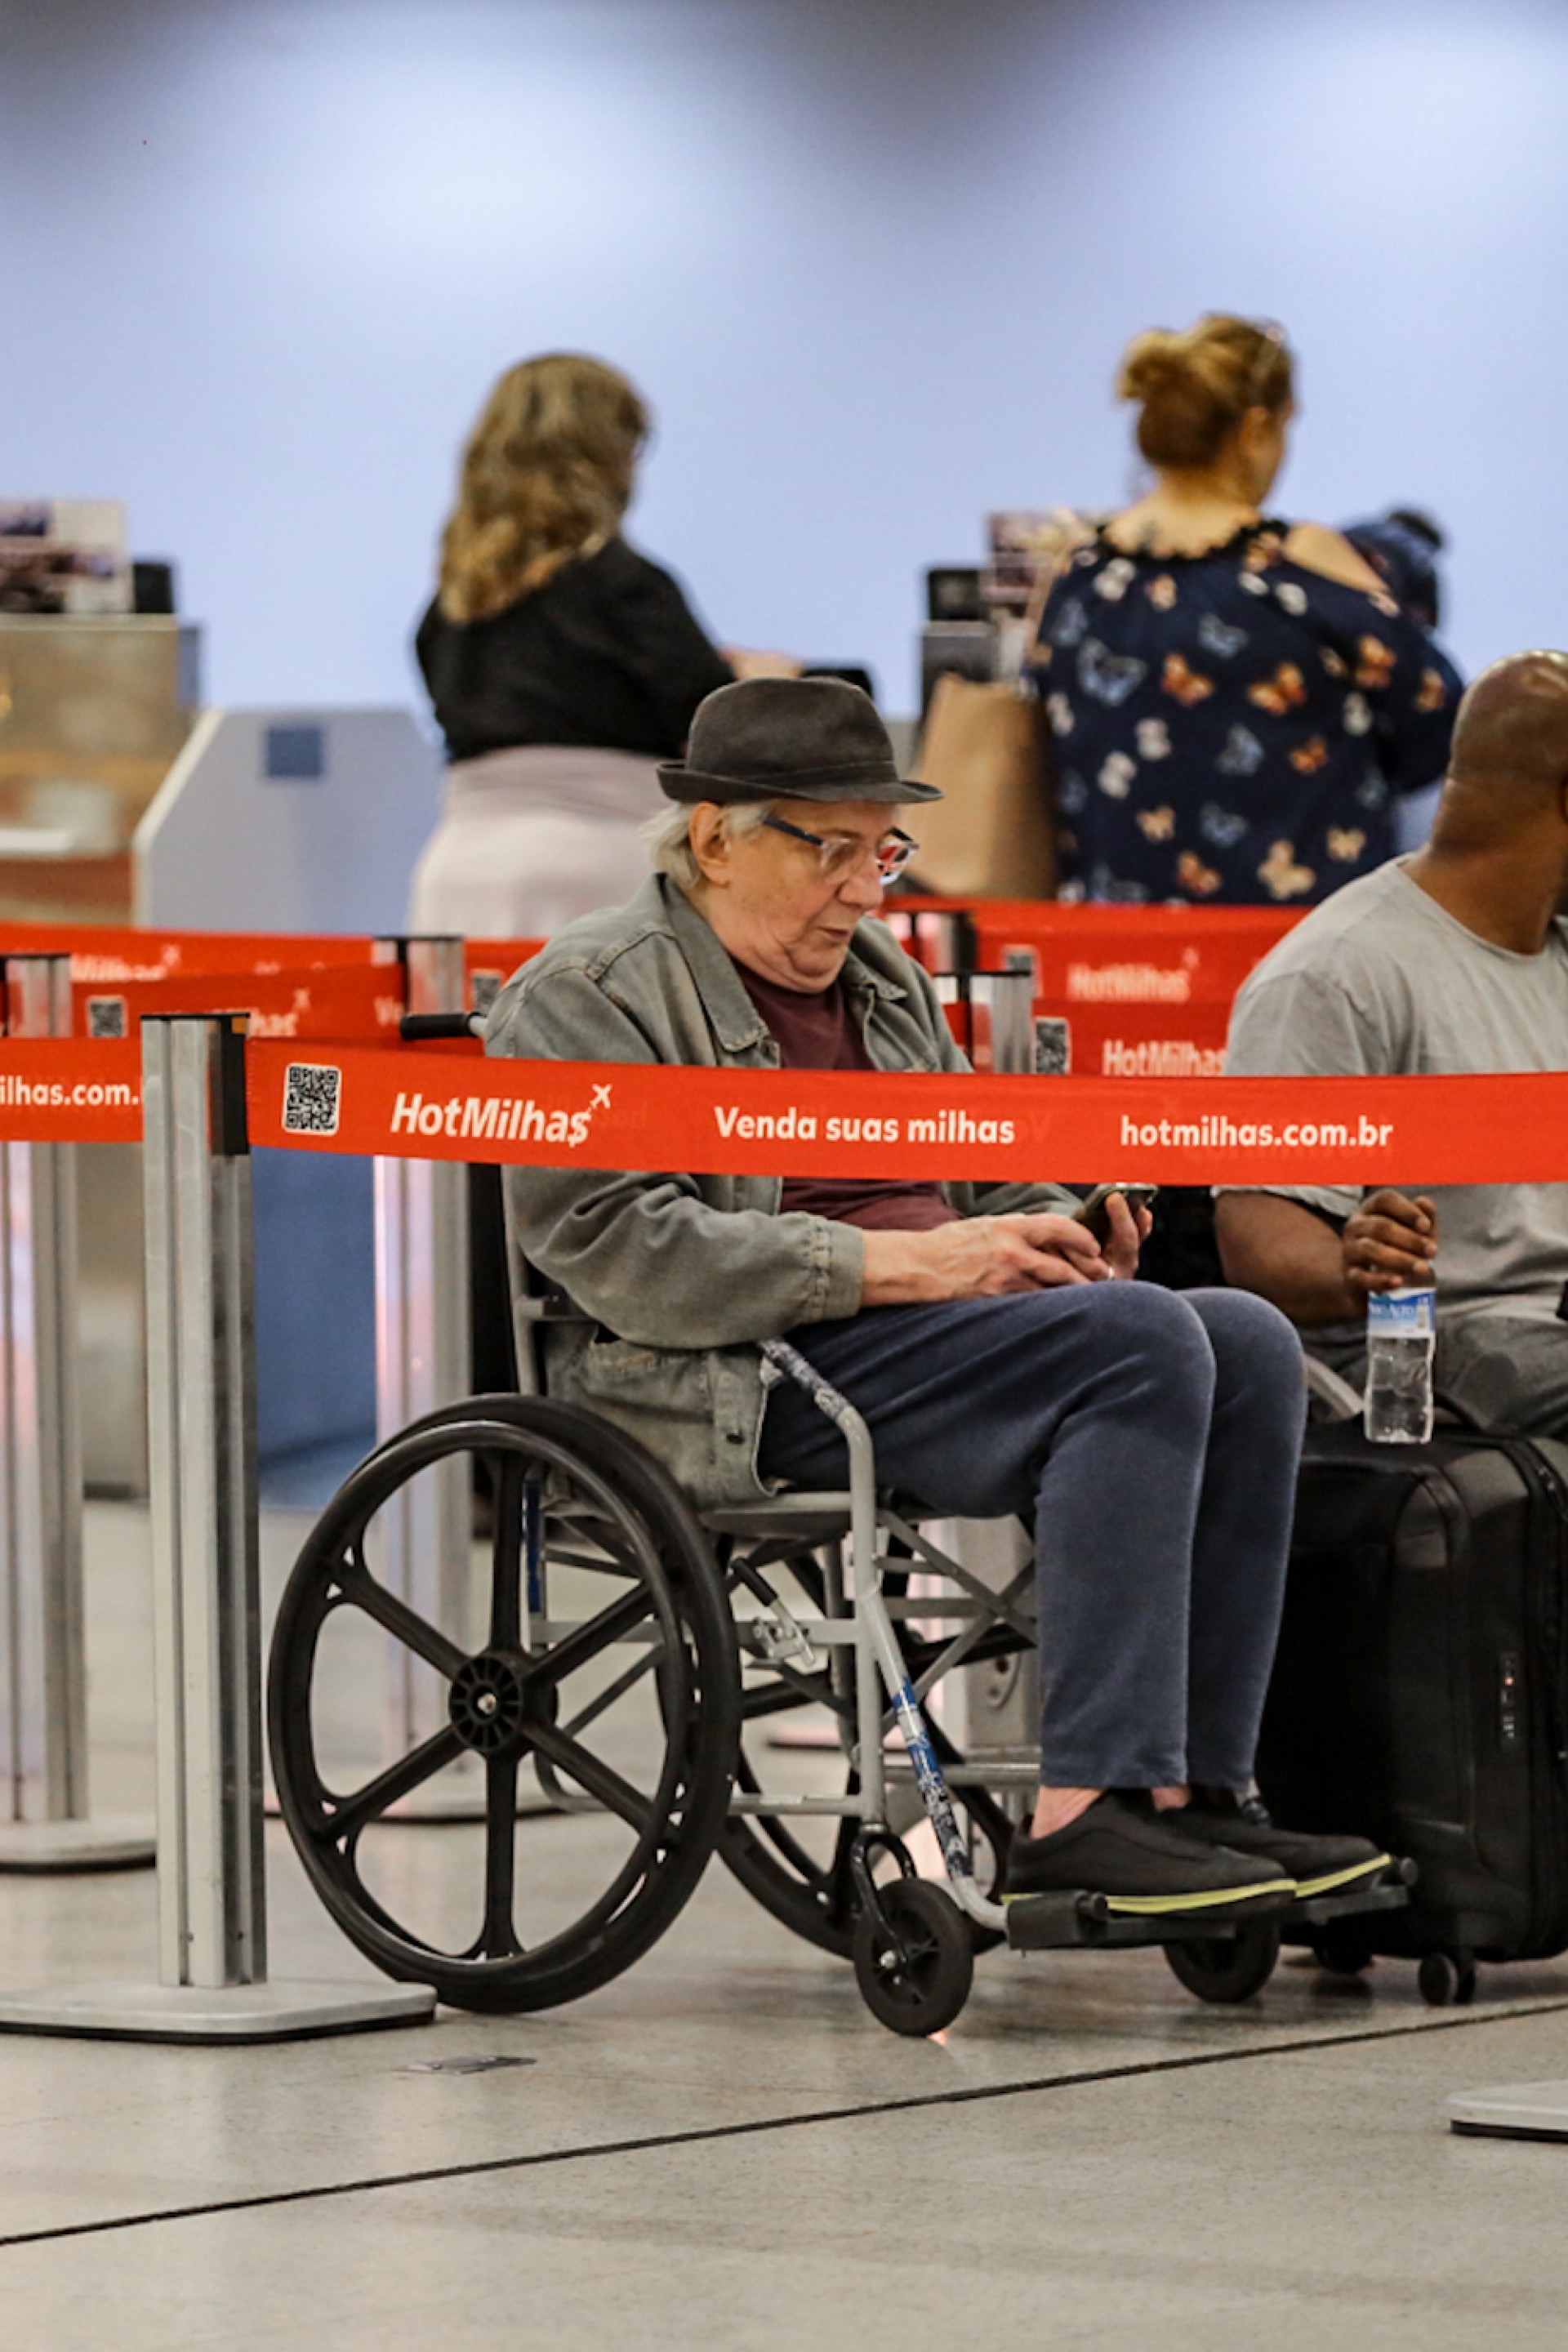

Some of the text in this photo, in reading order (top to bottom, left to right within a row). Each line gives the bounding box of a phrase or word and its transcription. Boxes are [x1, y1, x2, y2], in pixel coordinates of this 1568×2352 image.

[390, 1092, 1393, 1147] HotMilhas Venda suas milhas hotmilhas.com.br
